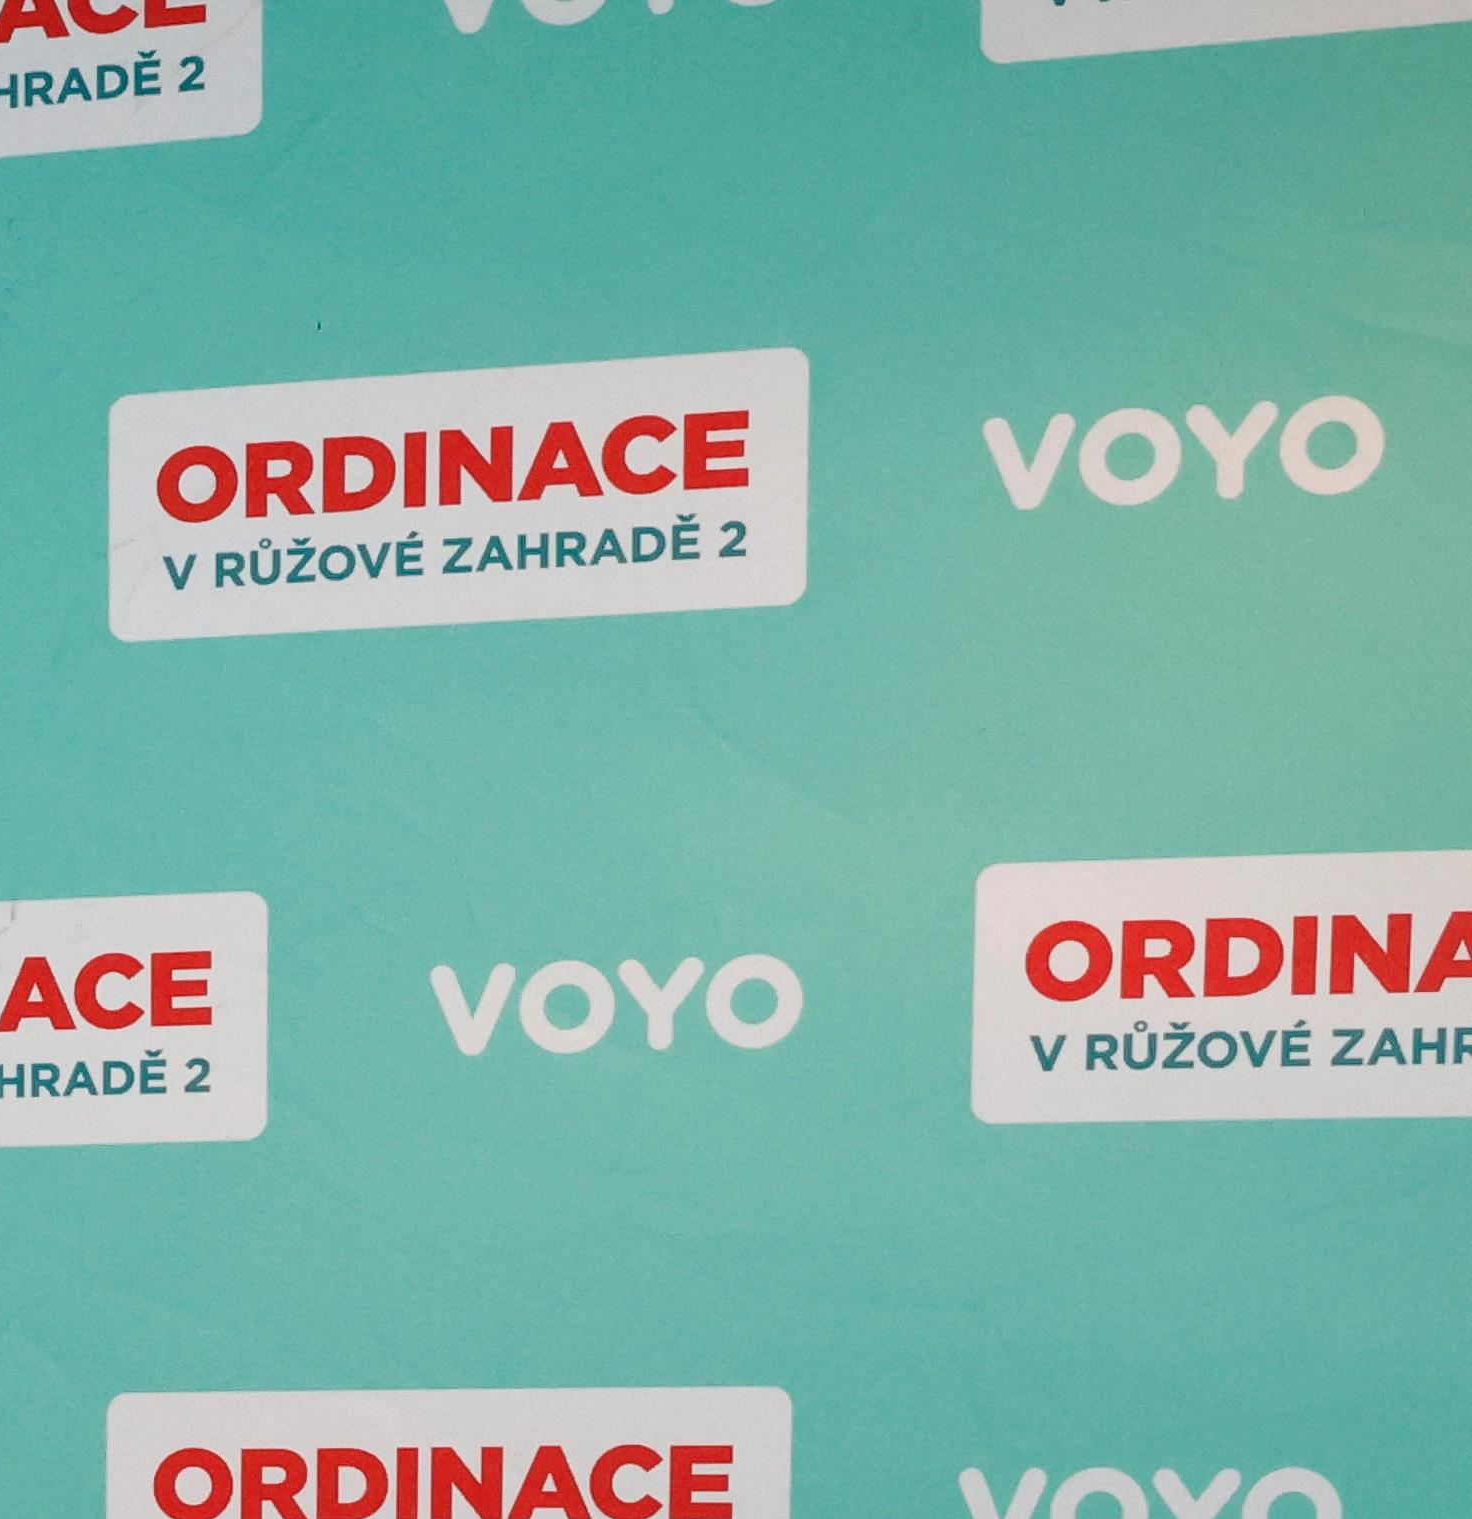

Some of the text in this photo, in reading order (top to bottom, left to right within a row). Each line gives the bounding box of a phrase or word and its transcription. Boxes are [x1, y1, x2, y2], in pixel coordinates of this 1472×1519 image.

[158, 411, 748, 522] ORDINACE
[982, 394, 1387, 511] VOYO
[162, 512, 747, 591] V RŮŽOVÉ ZAHRADĚ 2
[430, 953, 805, 1056] VOYO
[184, 1056, 211, 1094] 2
